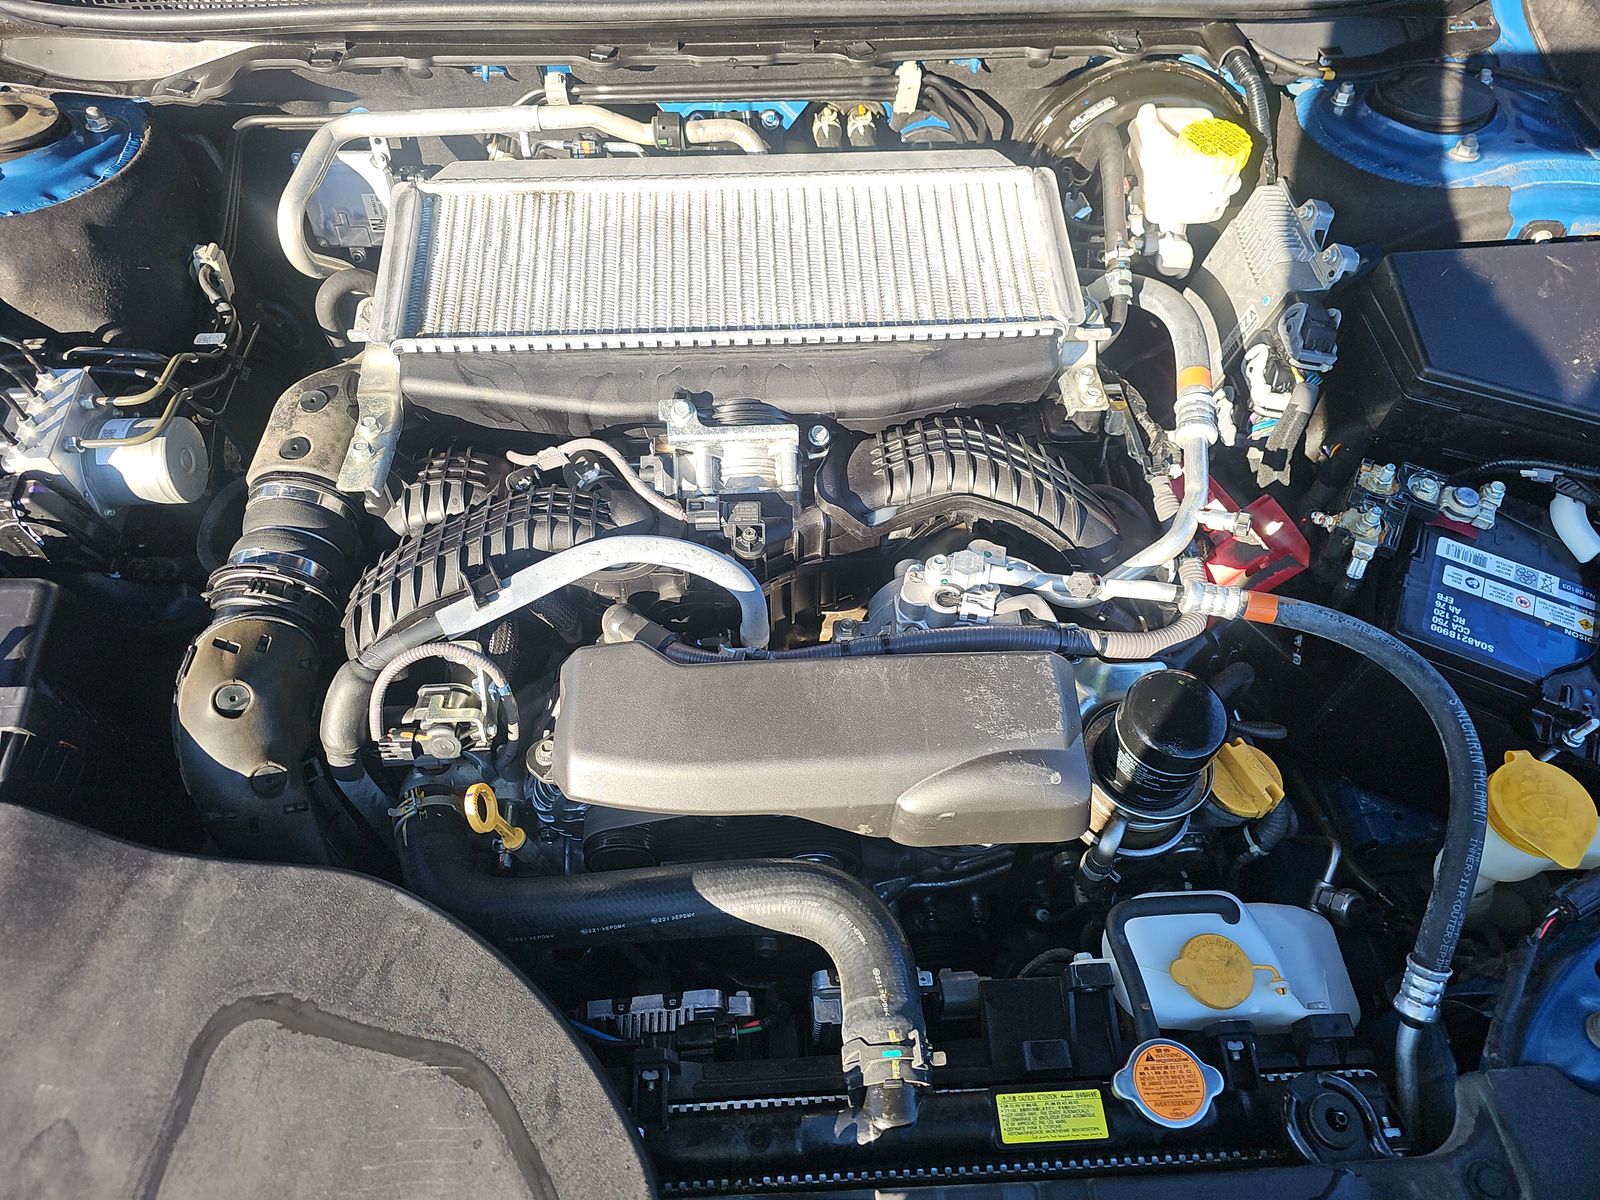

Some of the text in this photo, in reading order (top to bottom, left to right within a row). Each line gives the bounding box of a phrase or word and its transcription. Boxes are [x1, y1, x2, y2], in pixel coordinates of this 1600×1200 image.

[1434, 600, 1462, 614] Ah 76
[1436, 592, 1455, 605] EFB
[1432, 616, 1471, 636] CCA 750
[1433, 608, 1466, 626] RC 120
[1454, 705, 1484, 767] NICHIRIN
